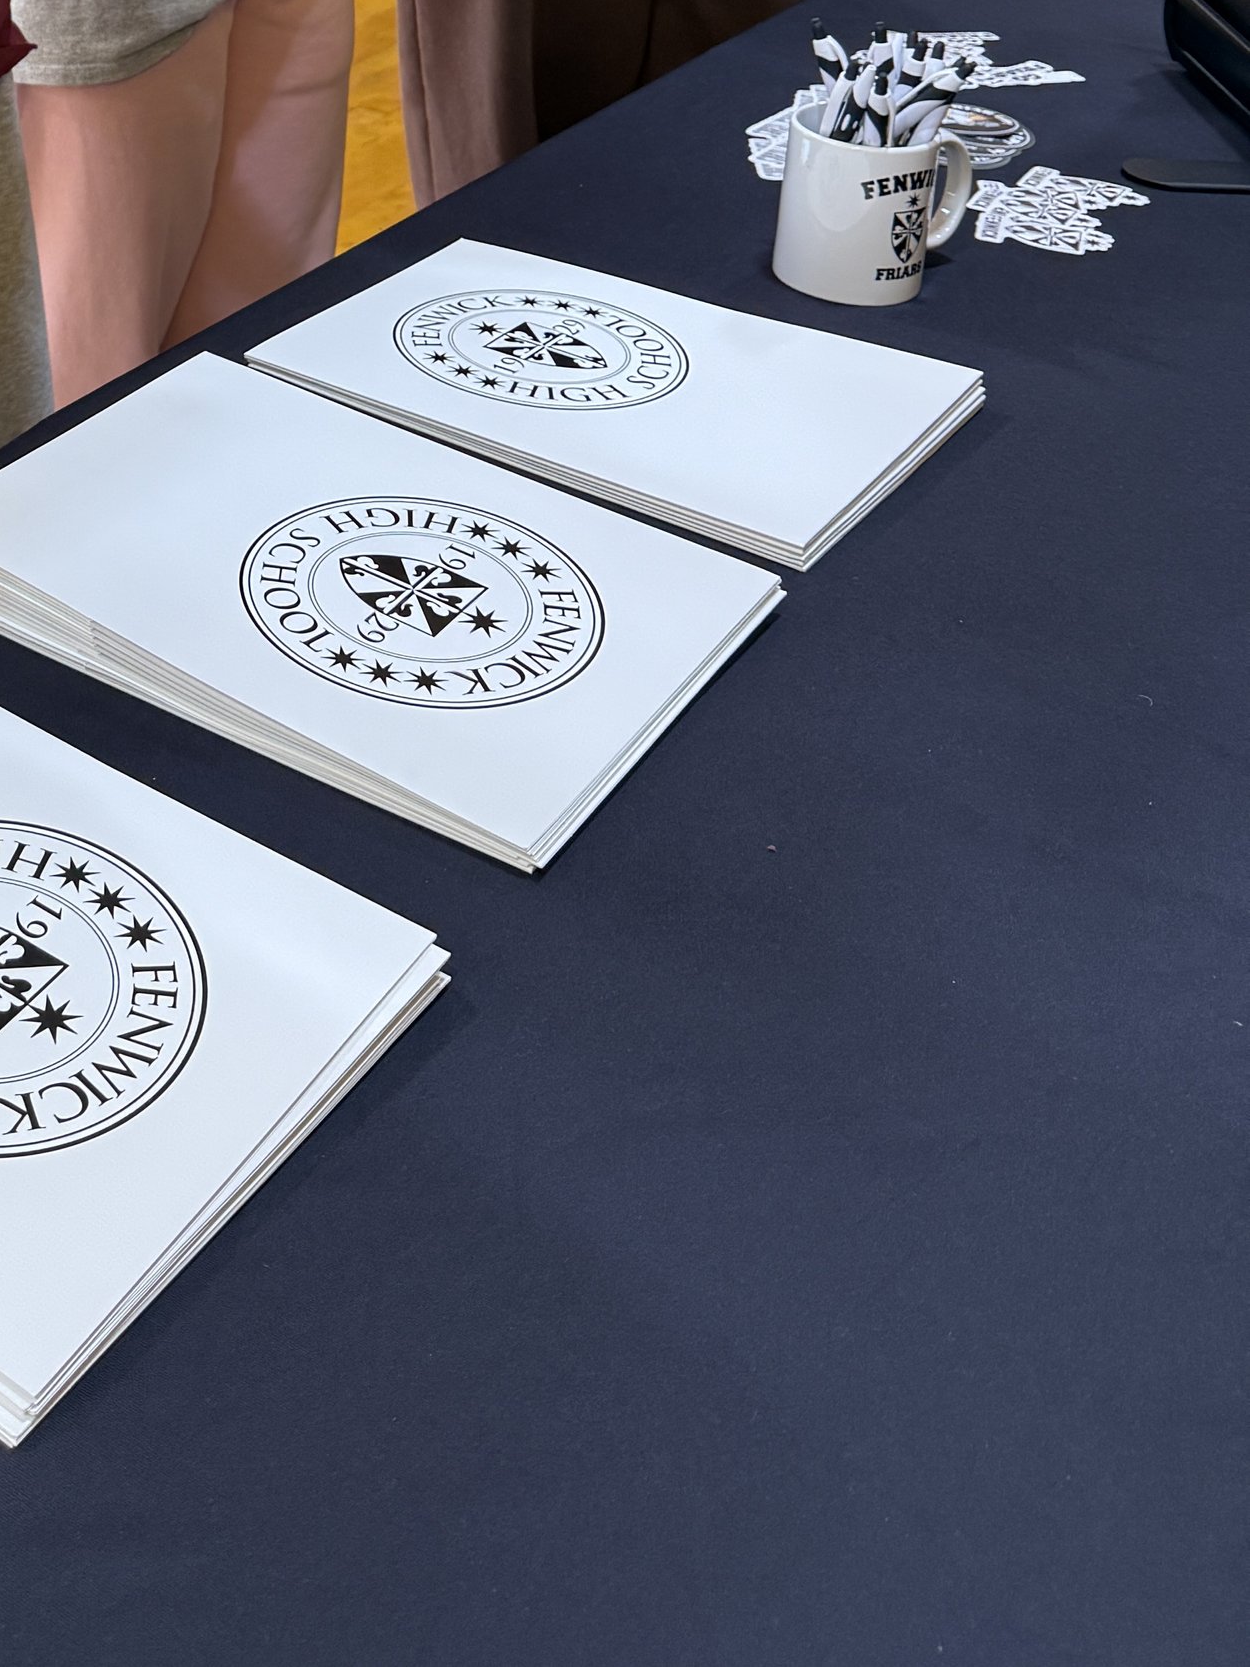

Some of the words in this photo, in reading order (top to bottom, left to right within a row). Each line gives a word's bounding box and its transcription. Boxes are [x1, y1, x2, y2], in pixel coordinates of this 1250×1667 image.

[875, 260, 922, 281] FRIARS
[411, 294, 517, 350] FENWICK
[507, 379, 633, 403] HIGH
[610, 316, 672, 390] SCHOOL
[493, 355, 526, 376] 19
[550, 318, 588, 338] 29
[322, 506, 465, 535] HIGH
[438, 543, 478, 573] 19
[258, 527, 336, 654] SCHOOL
[356, 611, 400, 644] 29
[450, 588, 581, 696] FENWICK
[16, 895, 65, 939] 19
